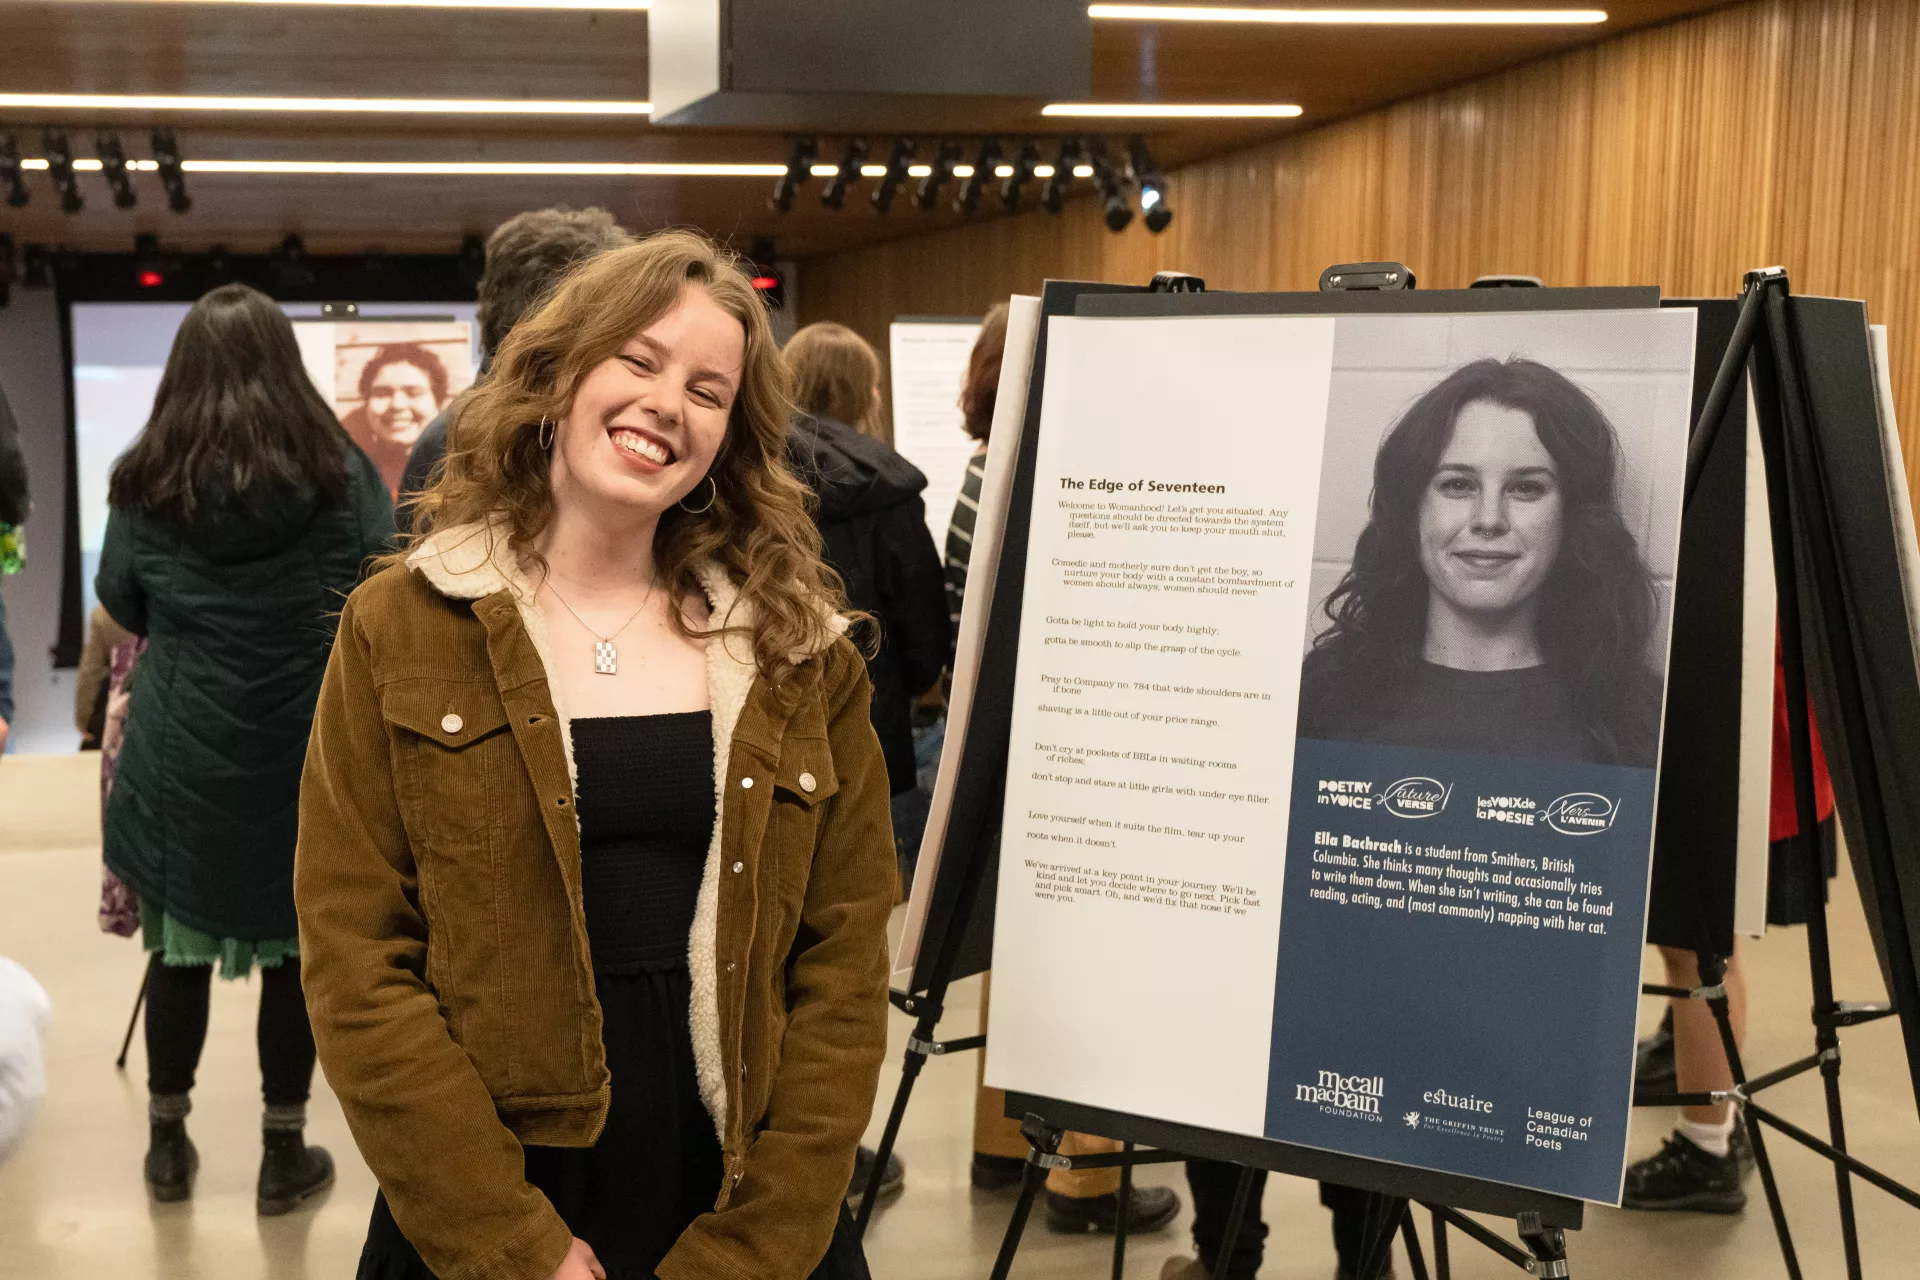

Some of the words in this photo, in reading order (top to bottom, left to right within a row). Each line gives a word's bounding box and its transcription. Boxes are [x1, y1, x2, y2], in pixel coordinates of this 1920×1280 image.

[1059, 477, 1084, 490] The
[1088, 478, 1123, 493] Edge
[1127, 479, 1144, 491] of
[1147, 480, 1225, 494] Seventeen
[1057, 500, 1095, 509] Welcome
[1108, 502, 1164, 512] Womanhood!
[1167, 504, 1187, 512] Let's
[1189, 506, 1204, 515] get
[1205, 507, 1224, 515] you
[1268, 508, 1288, 518] Any
[1045, 615, 1070, 625] Gotta
[1071, 617, 1081, 626] be
[1083, 618, 1104, 628] light
[1117, 620, 1136, 629] hold
[1138, 623, 1160, 632] your
[1162, 623, 1184, 634] body
[1186, 624, 1220, 636] highly;
[1043, 636, 1066, 645] gotta
[1068, 636, 1078, 645] be
[1079, 639, 1112, 648] smooth
[1124, 641, 1142, 651] slip
[1143, 642, 1158, 650] the
[1159, 645, 1186, 655] grasp
[1188, 645, 1198, 653] of
[1200, 646, 1214, 654] the
[1216, 648, 1242, 657] cycle.
[1040, 674, 1061, 685] Pray
[1063, 676, 1072, 684] to
[1073, 676, 1115, 687] Company
[1133, 682, 1149, 690] 784
[1152, 683, 1170, 692] that
[1173, 685, 1194, 694] wide
[1196, 686, 1242, 698] shoulders
[1061, 685, 1081, 694] bone
[1037, 703, 1072, 715] shaving
[1074, 706, 1082, 714] is
[1091, 707, 1112, 717] little
[1130, 711, 1140, 719] of
[1141, 714, 1163, 722] your
[1164, 715, 1188, 724] price
[1190, 718, 1220, 728] range.
[1034, 742, 1057, 752] Don't
[1058, 746, 1073, 755] cry
[1085, 748, 1119, 758] pockets
[1132, 751, 1156, 761] BBLs
[1170, 756, 1206, 768] waiting
[1208, 761, 1237, 769] rooms
[1045, 753, 1055, 761] of
[1031, 771, 1053, 781] don't
[1054, 775, 1073, 785] stop
[1074, 777, 1091, 785] and
[1093, 779, 1116, 787] stare
[1129, 781, 1150, 791] little
[1151, 784, 1173, 794] girls
[1175, 787, 1195, 796] with
[1199, 790, 1226, 799] under
[1228, 793, 1244, 802] eye
[1247, 793, 1272, 803] filler.
[1319, 780, 1372, 794] POETRY
[1385, 782, 1443, 802] Future
[1397, 799, 1434, 810] VERSE
[1028, 809, 1048, 820] Love
[1049, 814, 1086, 824] yourself
[1088, 818, 1112, 828] when
[1122, 822, 1145, 831] suits
[1147, 824, 1162, 832] the
[1164, 825, 1184, 836] film,
[1187, 829, 1205, 838] tear
[1208, 832, 1220, 842] up
[1222, 834, 1245, 843] your
[1560, 816, 1606, 827] L'AVENIR
[1026, 831, 1048, 840] roots
[1050, 833, 1074, 843] when
[1076, 836, 1083, 844] it
[1084, 837, 1118, 848] doesn't.
[1314, 831, 1338, 846] Ella
[1342, 834, 1402, 853] Bachrach
[1404, 841, 1412, 855] is
[1415, 846, 1421, 856] a
[1424, 844, 1461, 860] student
[1464, 846, 1488, 863] from
[1491, 850, 1538, 871] Smithers,
[1542, 856, 1574, 873] British
[1313, 849, 1359, 867] Columbia.
[1362, 854, 1380, 869] She
[1383, 857, 1412, 873] thinks
[1415, 864, 1443, 880] many
[1446, 864, 1489, 884] thoughts
[1492, 871, 1512, 885] and
[1514, 876, 1577, 895] occasionally
[1579, 881, 1602, 896] tries
[1034, 891, 1055, 900] were
[1056, 894, 1075, 902] you.
[1311, 868, 1320, 880] to
[1323, 870, 1346, 883] write
[1349, 871, 1373, 887] them
[1376, 874, 1404, 891] down.
[1408, 878, 1435, 894] When
[1438, 881, 1455, 897] she
[1458, 885, 1480, 900] isn't
[1482, 889, 1520, 908] writing,
[1524, 891, 1542, 907] she
[1545, 898, 1562, 910] can
[1566, 896, 1579, 912] be
[1582, 898, 1613, 916] found
[1310, 887, 1348, 904] reading,
[1351, 892, 1382, 909] acting,
[1386, 896, 1404, 909] and
[1408, 896, 1436, 913] (most
[1438, 904, 1494, 923] commonly)
[1497, 911, 1539, 929] napping
[1542, 915, 1564, 929] with
[1567, 916, 1585, 932] her
[1588, 922, 1606, 934] cat.
[1423, 1088, 1493, 1114] estuaire
[1320, 1105, 1383, 1122] FOUNDATION
[1528, 1106, 1575, 1124] League
[1580, 1116, 1593, 1128] of
[1424, 1116, 1440, 1124] THE
[1442, 1120, 1476, 1131] GRIFFIN
[1479, 1126, 1505, 1136] TRUST
[1526, 1120, 1588, 1141] Canadian
[1526, 1134, 1562, 1151] Poets
